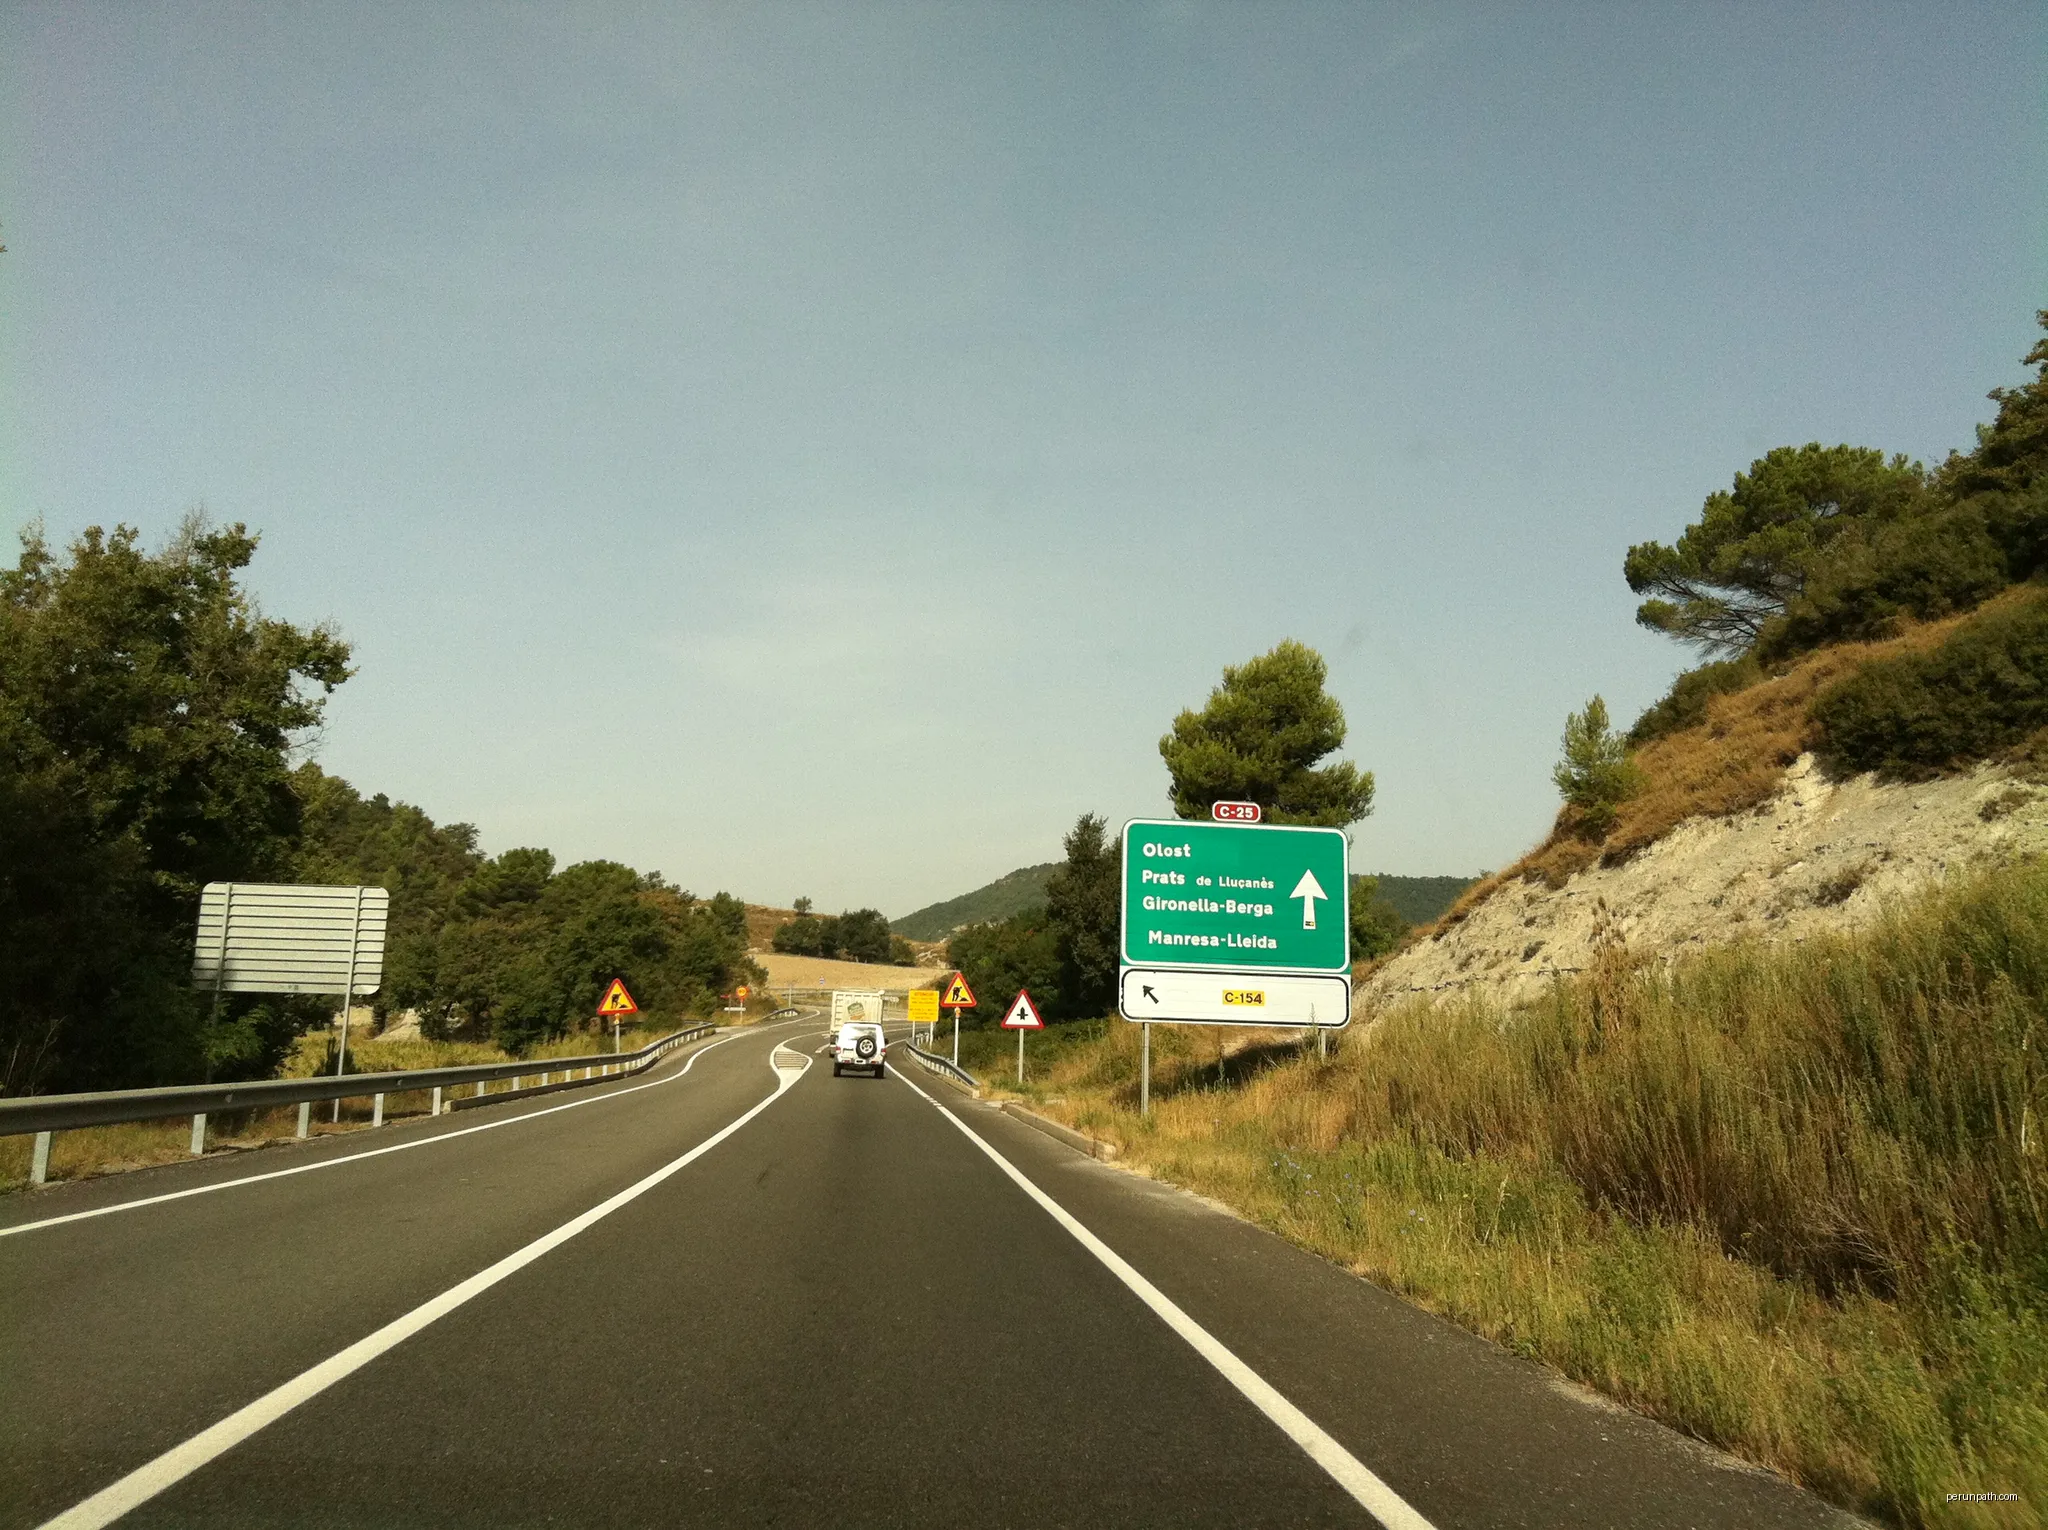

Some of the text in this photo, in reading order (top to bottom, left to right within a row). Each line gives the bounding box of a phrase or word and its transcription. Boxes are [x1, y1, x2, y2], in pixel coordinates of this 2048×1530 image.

[1219, 806, 1254, 819] C-25
[1142, 842, 1191, 858] Olost
[1142, 869, 1186, 885] Prats
[1196, 876, 1212, 887] de
[1142, 895, 1274, 918] Gironella-Berga
[1148, 929, 1278, 949] Manresa-Lleida
[1224, 992, 1263, 1005] C-154
